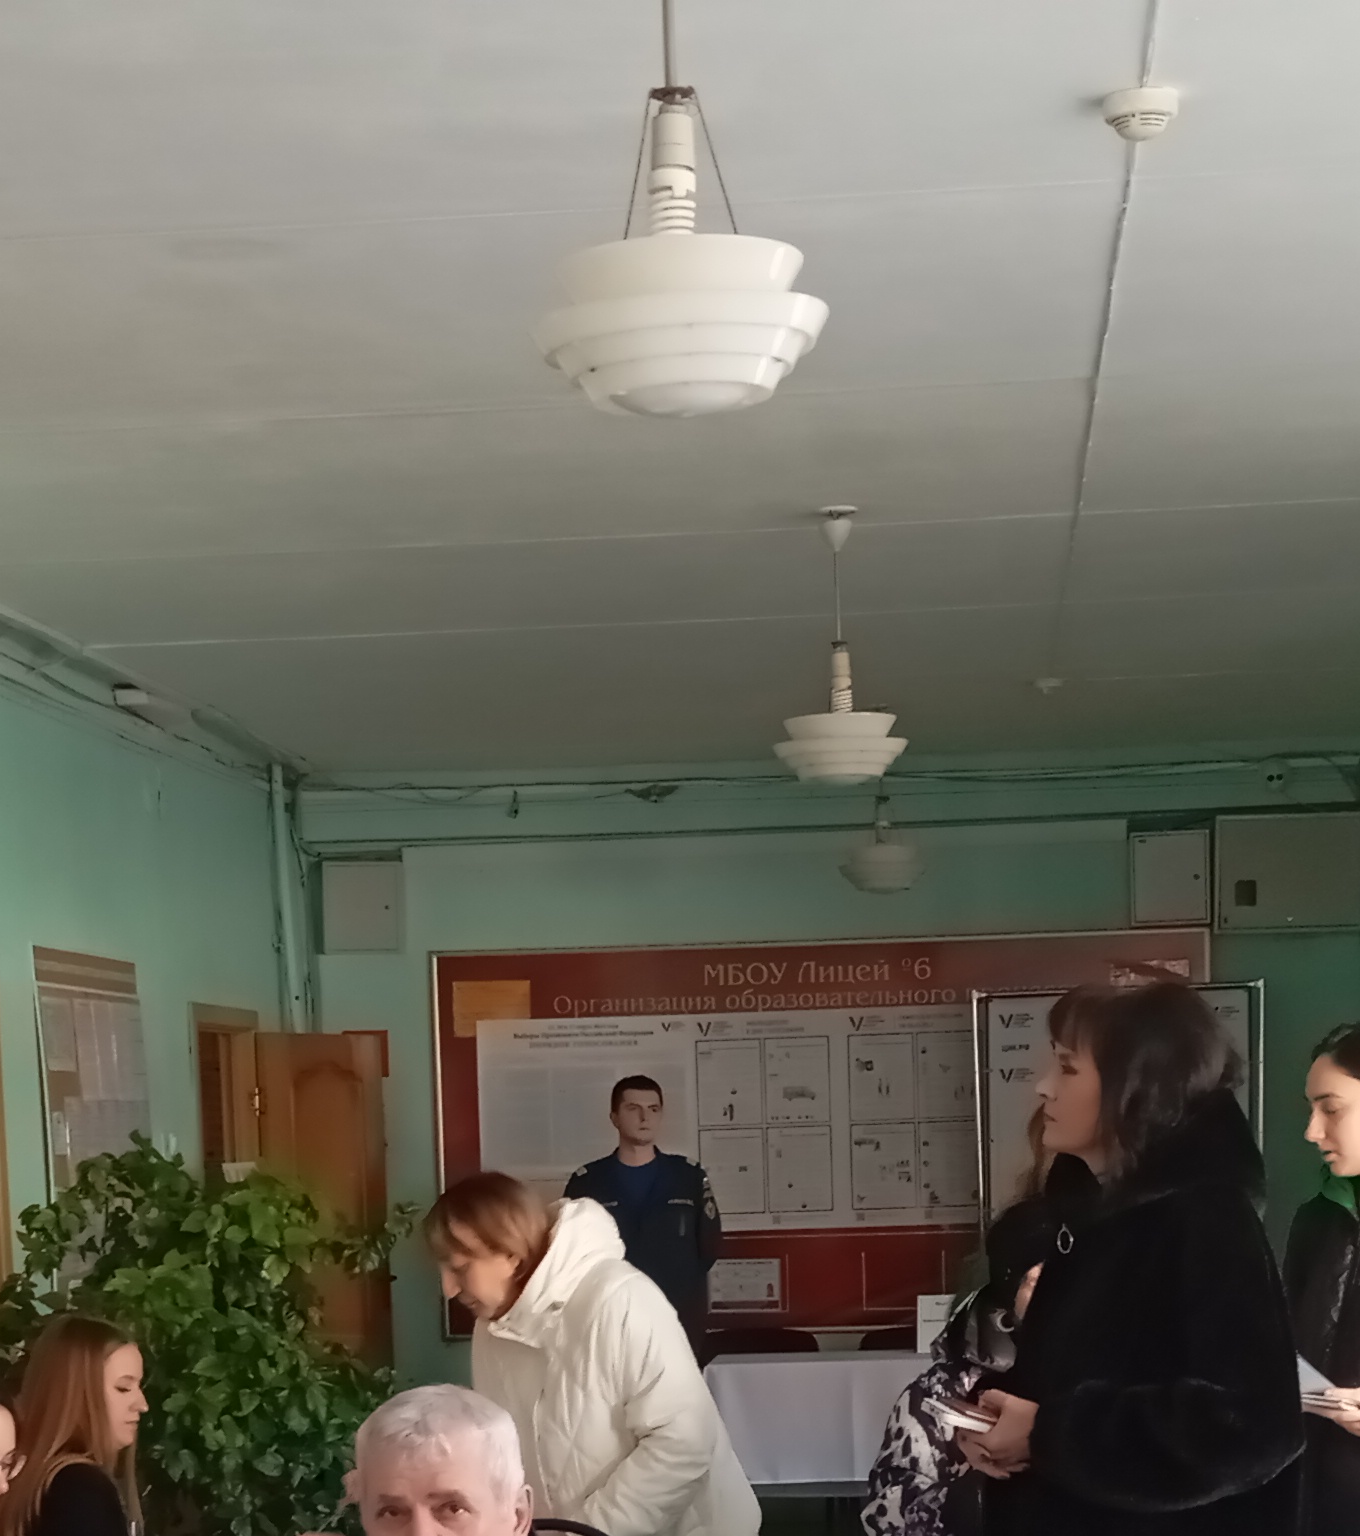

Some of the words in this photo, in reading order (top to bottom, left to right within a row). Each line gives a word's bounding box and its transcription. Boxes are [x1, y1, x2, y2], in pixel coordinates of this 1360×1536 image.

[703, 961, 788, 987] МБОУ
[797, 957, 890, 985] Лицей
[553, 992, 717, 1019] Организация
[724, 988, 956, 1012] образовательного
